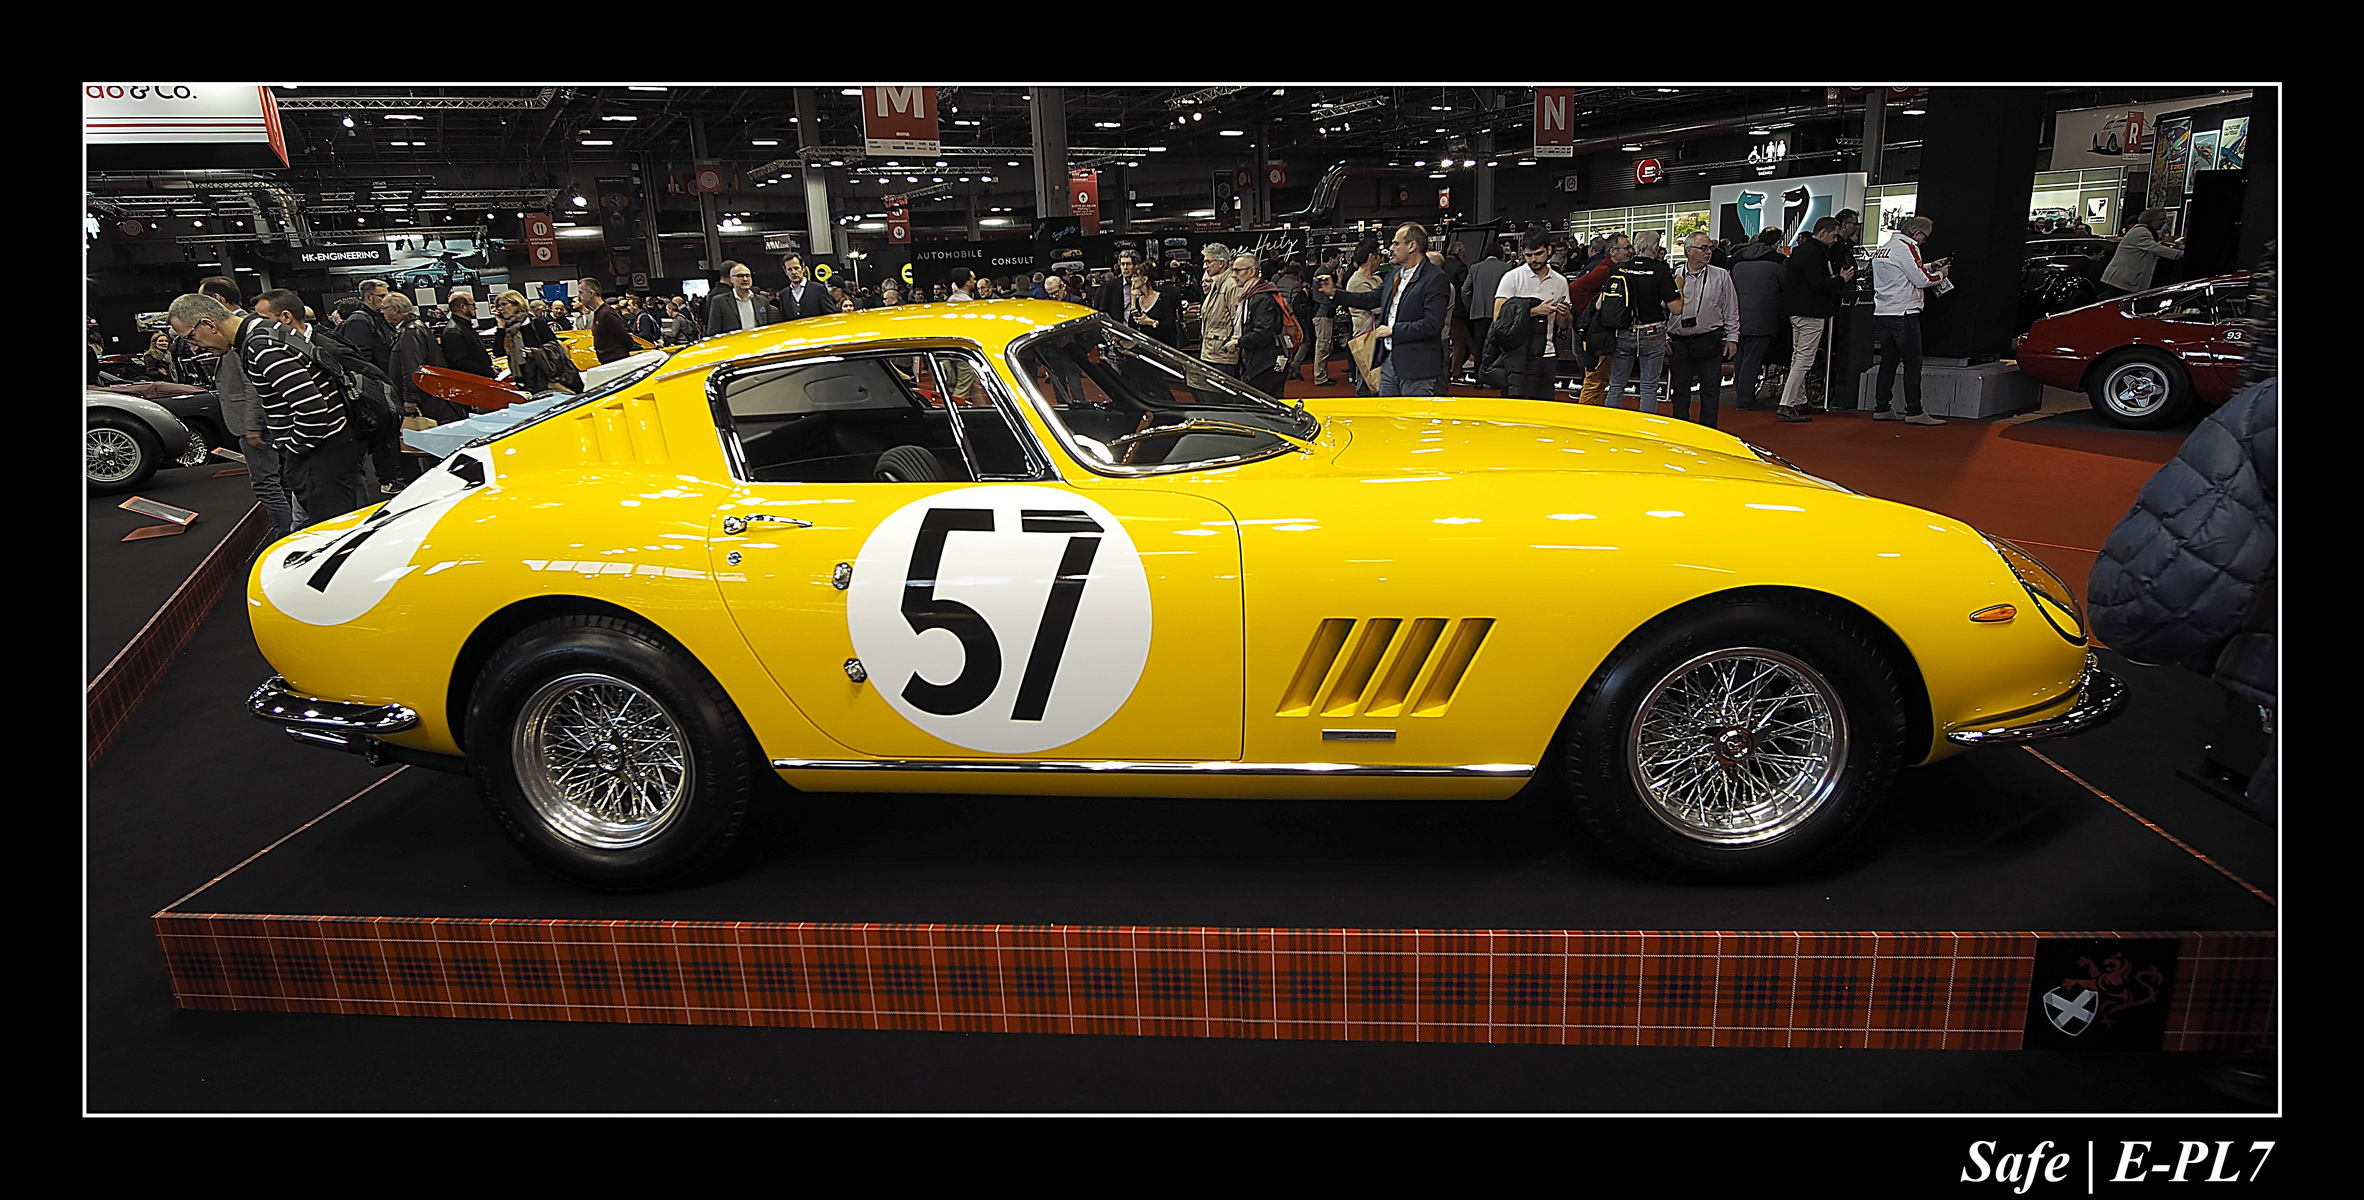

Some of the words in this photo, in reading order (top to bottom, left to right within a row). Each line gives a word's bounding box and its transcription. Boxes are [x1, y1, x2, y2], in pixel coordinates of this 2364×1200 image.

[154, 86, 197, 99] Co.
[876, 86, 925, 118] M
[1544, 95, 1566, 131] N
[2128, 122, 2139, 145] R
[301, 250, 380, 262] HK-ENGINEERING
[916, 249, 983, 261] AUTOMOBILE
[991, 256, 1035, 266] CONSULT
[2226, 331, 2243, 340] 93
[900, 508, 1105, 722] 57
